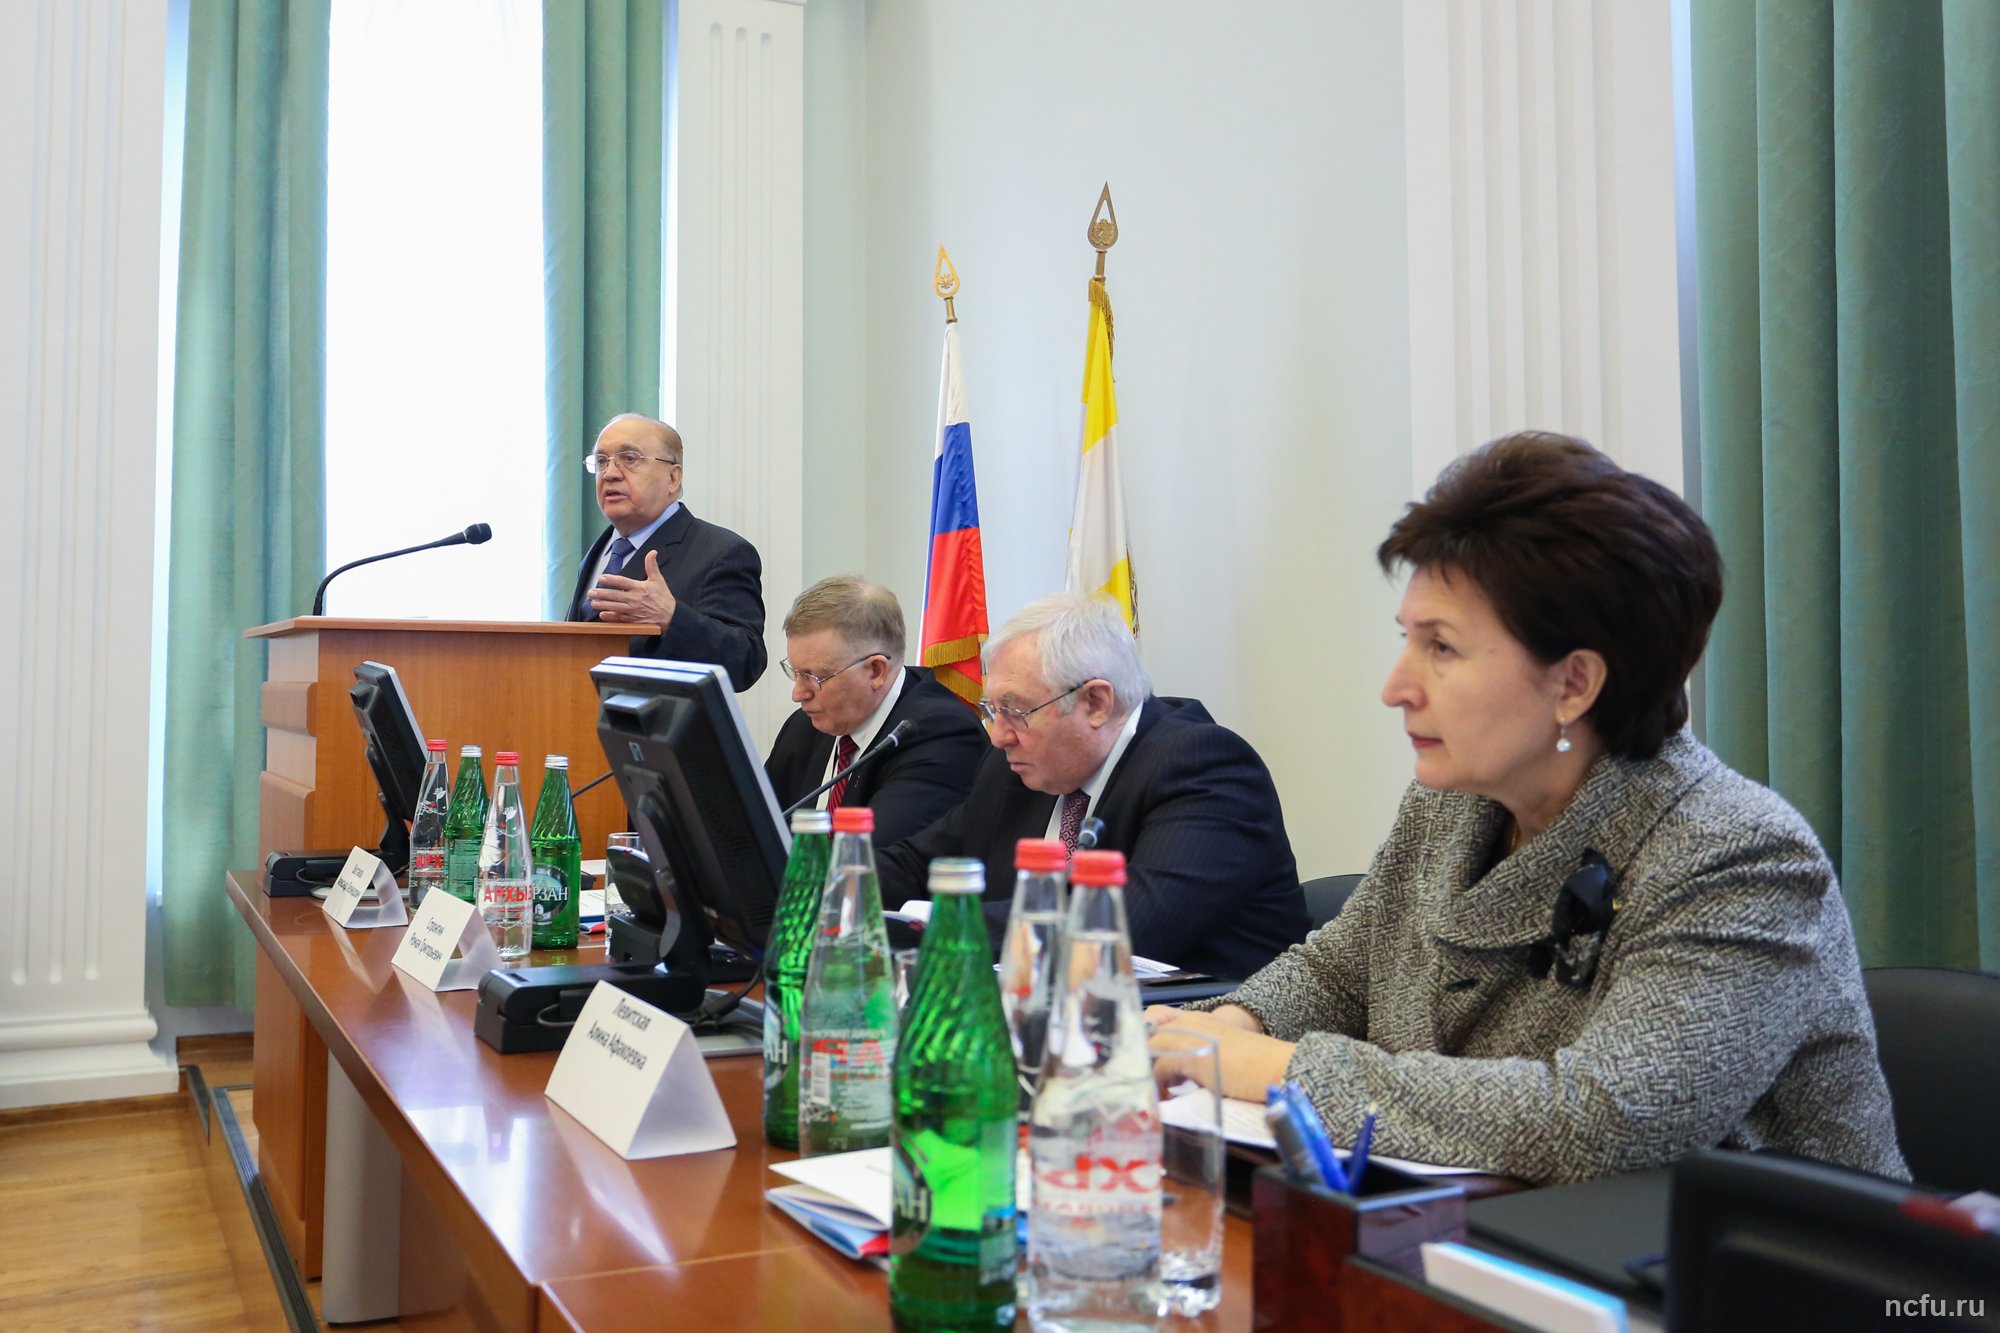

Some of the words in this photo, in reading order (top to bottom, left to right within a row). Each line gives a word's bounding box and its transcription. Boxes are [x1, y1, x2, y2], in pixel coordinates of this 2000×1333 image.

[415, 853, 444, 868] АРХ
[533, 886, 568, 901] РЗАН
[613, 998, 651, 1031] Левитская
[587, 1021, 610, 1047] Алина
